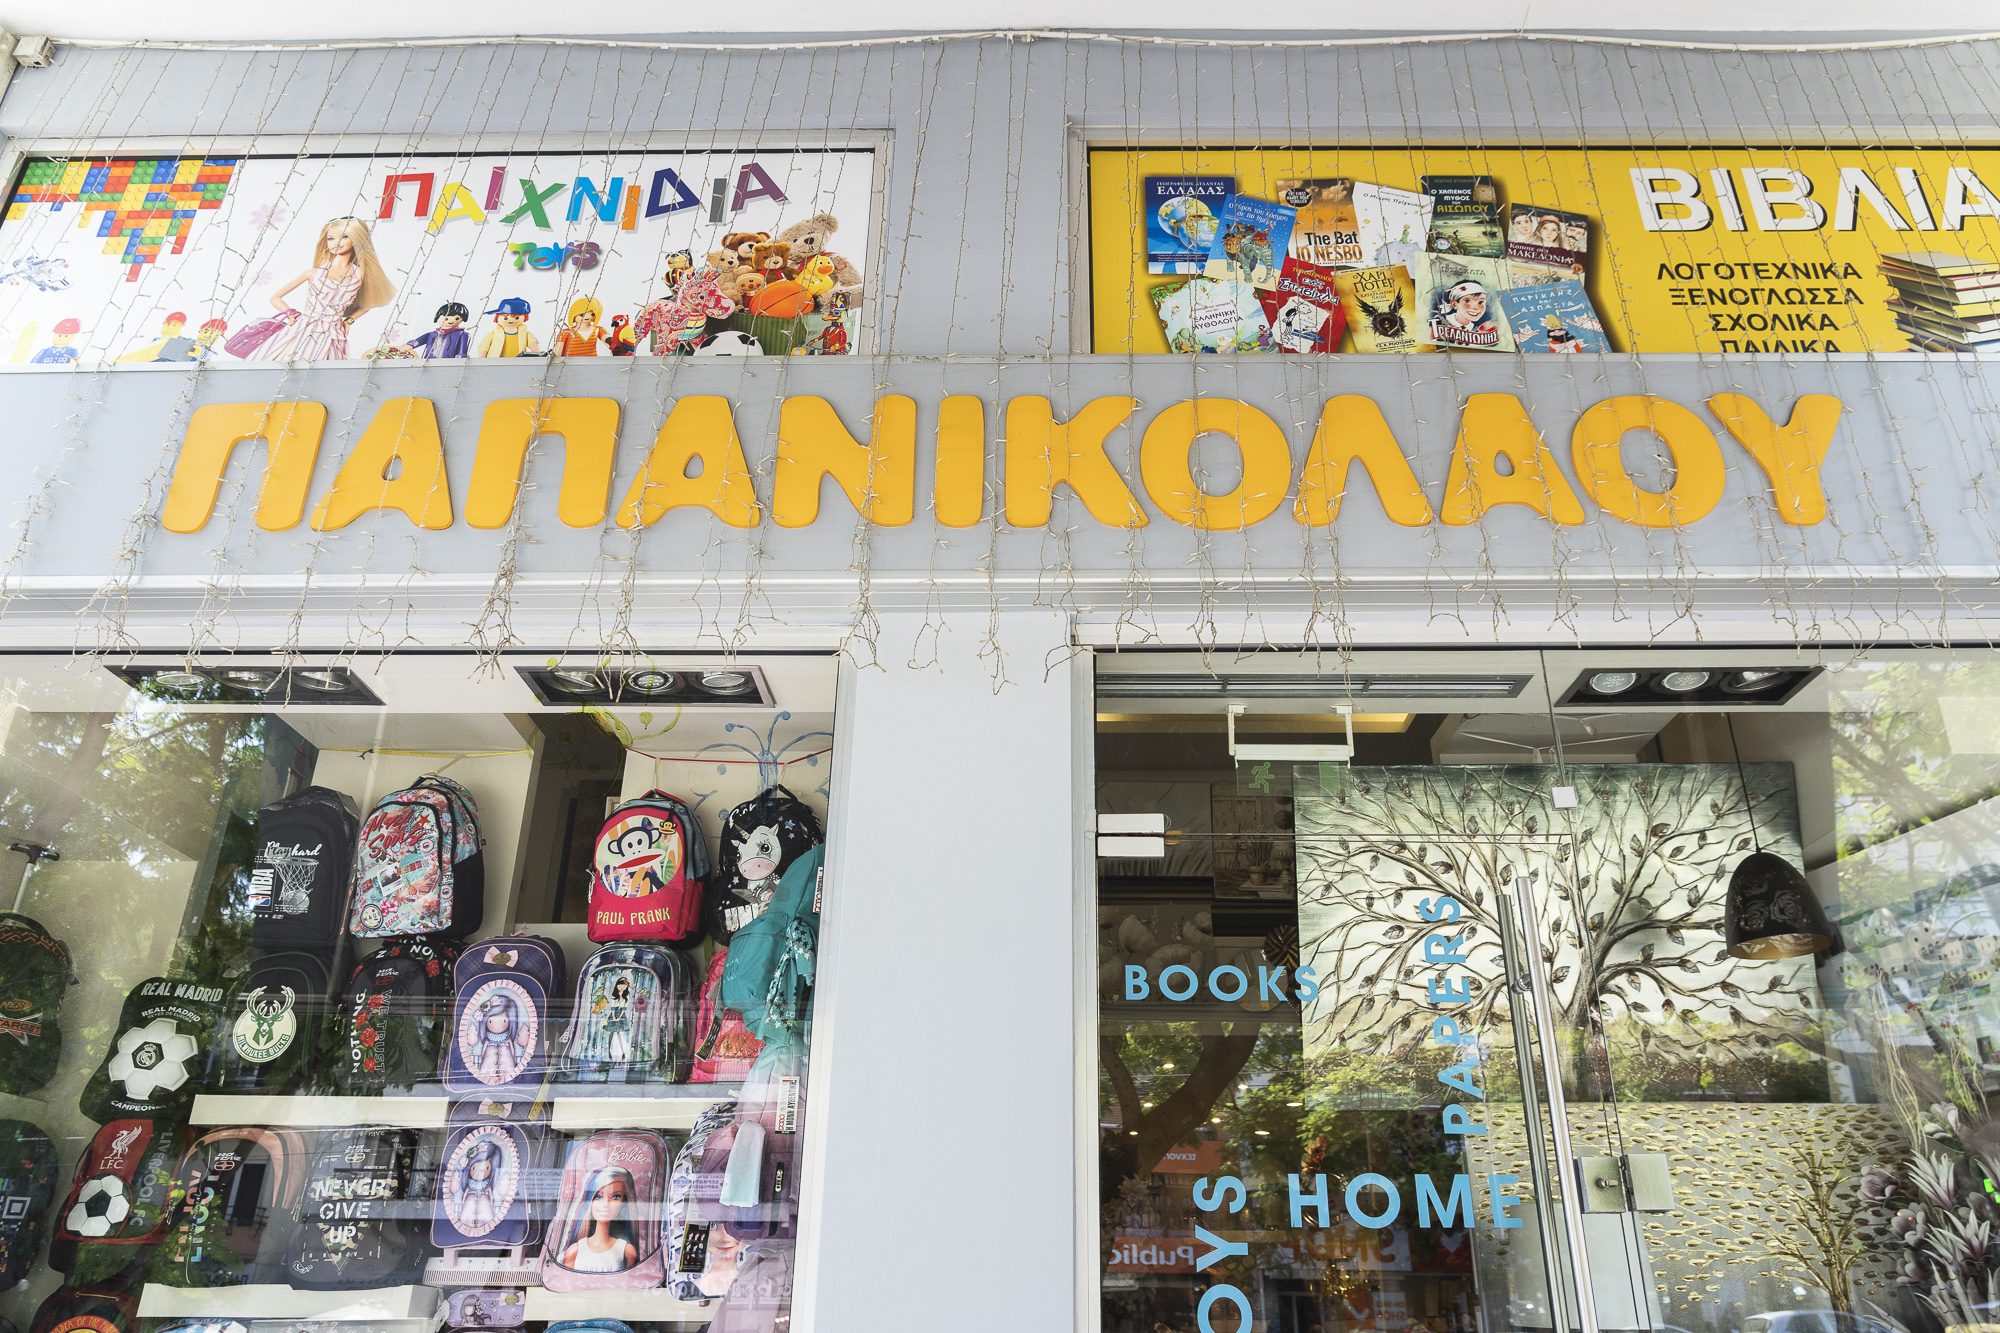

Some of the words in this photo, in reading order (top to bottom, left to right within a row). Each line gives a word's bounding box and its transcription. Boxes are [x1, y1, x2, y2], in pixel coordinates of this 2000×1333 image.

[379, 162, 788, 231] ΠΑΙΧΝΙΔΙΑ
[1157, 186, 1225, 195] ΕΛΛΑΔΑΣ
[1629, 167, 2000, 232] ΒΙΒΛΙΑ
[1437, 205, 1489, 213] ΑΙΣΩΠΟΥ
[1304, 232, 1331, 246] The
[1334, 231, 1360, 244] Bat
[509, 242, 600, 271] TOYS
[1657, 262, 1863, 280] ΛΟΓΟΤΕΧΝΙΚΑ
[1353, 278, 1395, 293] ΠΟΤΕΡ
[1669, 288, 1865, 305] ΞΕΝΟΓΛΩΣΣΑ
[1427, 318, 1499, 344] ΤΡΕΛΑΝΤΩΝΗΣ
[1711, 314, 1840, 331] ΣΧΟΛΙΚΑ
[162, 393, 1843, 533] ΠΑΠΑΝΙΚΟΛΑΟΥ
[292, 844, 322, 857] hard
[250, 868, 275, 896] NBA
[596, 911, 625, 925] PAUL
[630, 907, 671, 925] FRANK
[141, 982, 171, 996] REAL
[174, 983, 224, 1002] MADRID
[1125, 964, 1319, 1002] BOOKS
[142, 1006, 166, 1018] REAL
[168, 1005, 201, 1023] MADRID
[1419, 896, 1487, 1135] PAPERS
[268, 1034, 291, 1056] BUCKS
[608, 1144, 647, 1162] Barbie
[315, 1178, 386, 1198] NEVER
[1288, 1172, 1524, 1229] HOME
[319, 1202, 371, 1220] GIVE
[329, 1226, 357, 1244] UP
